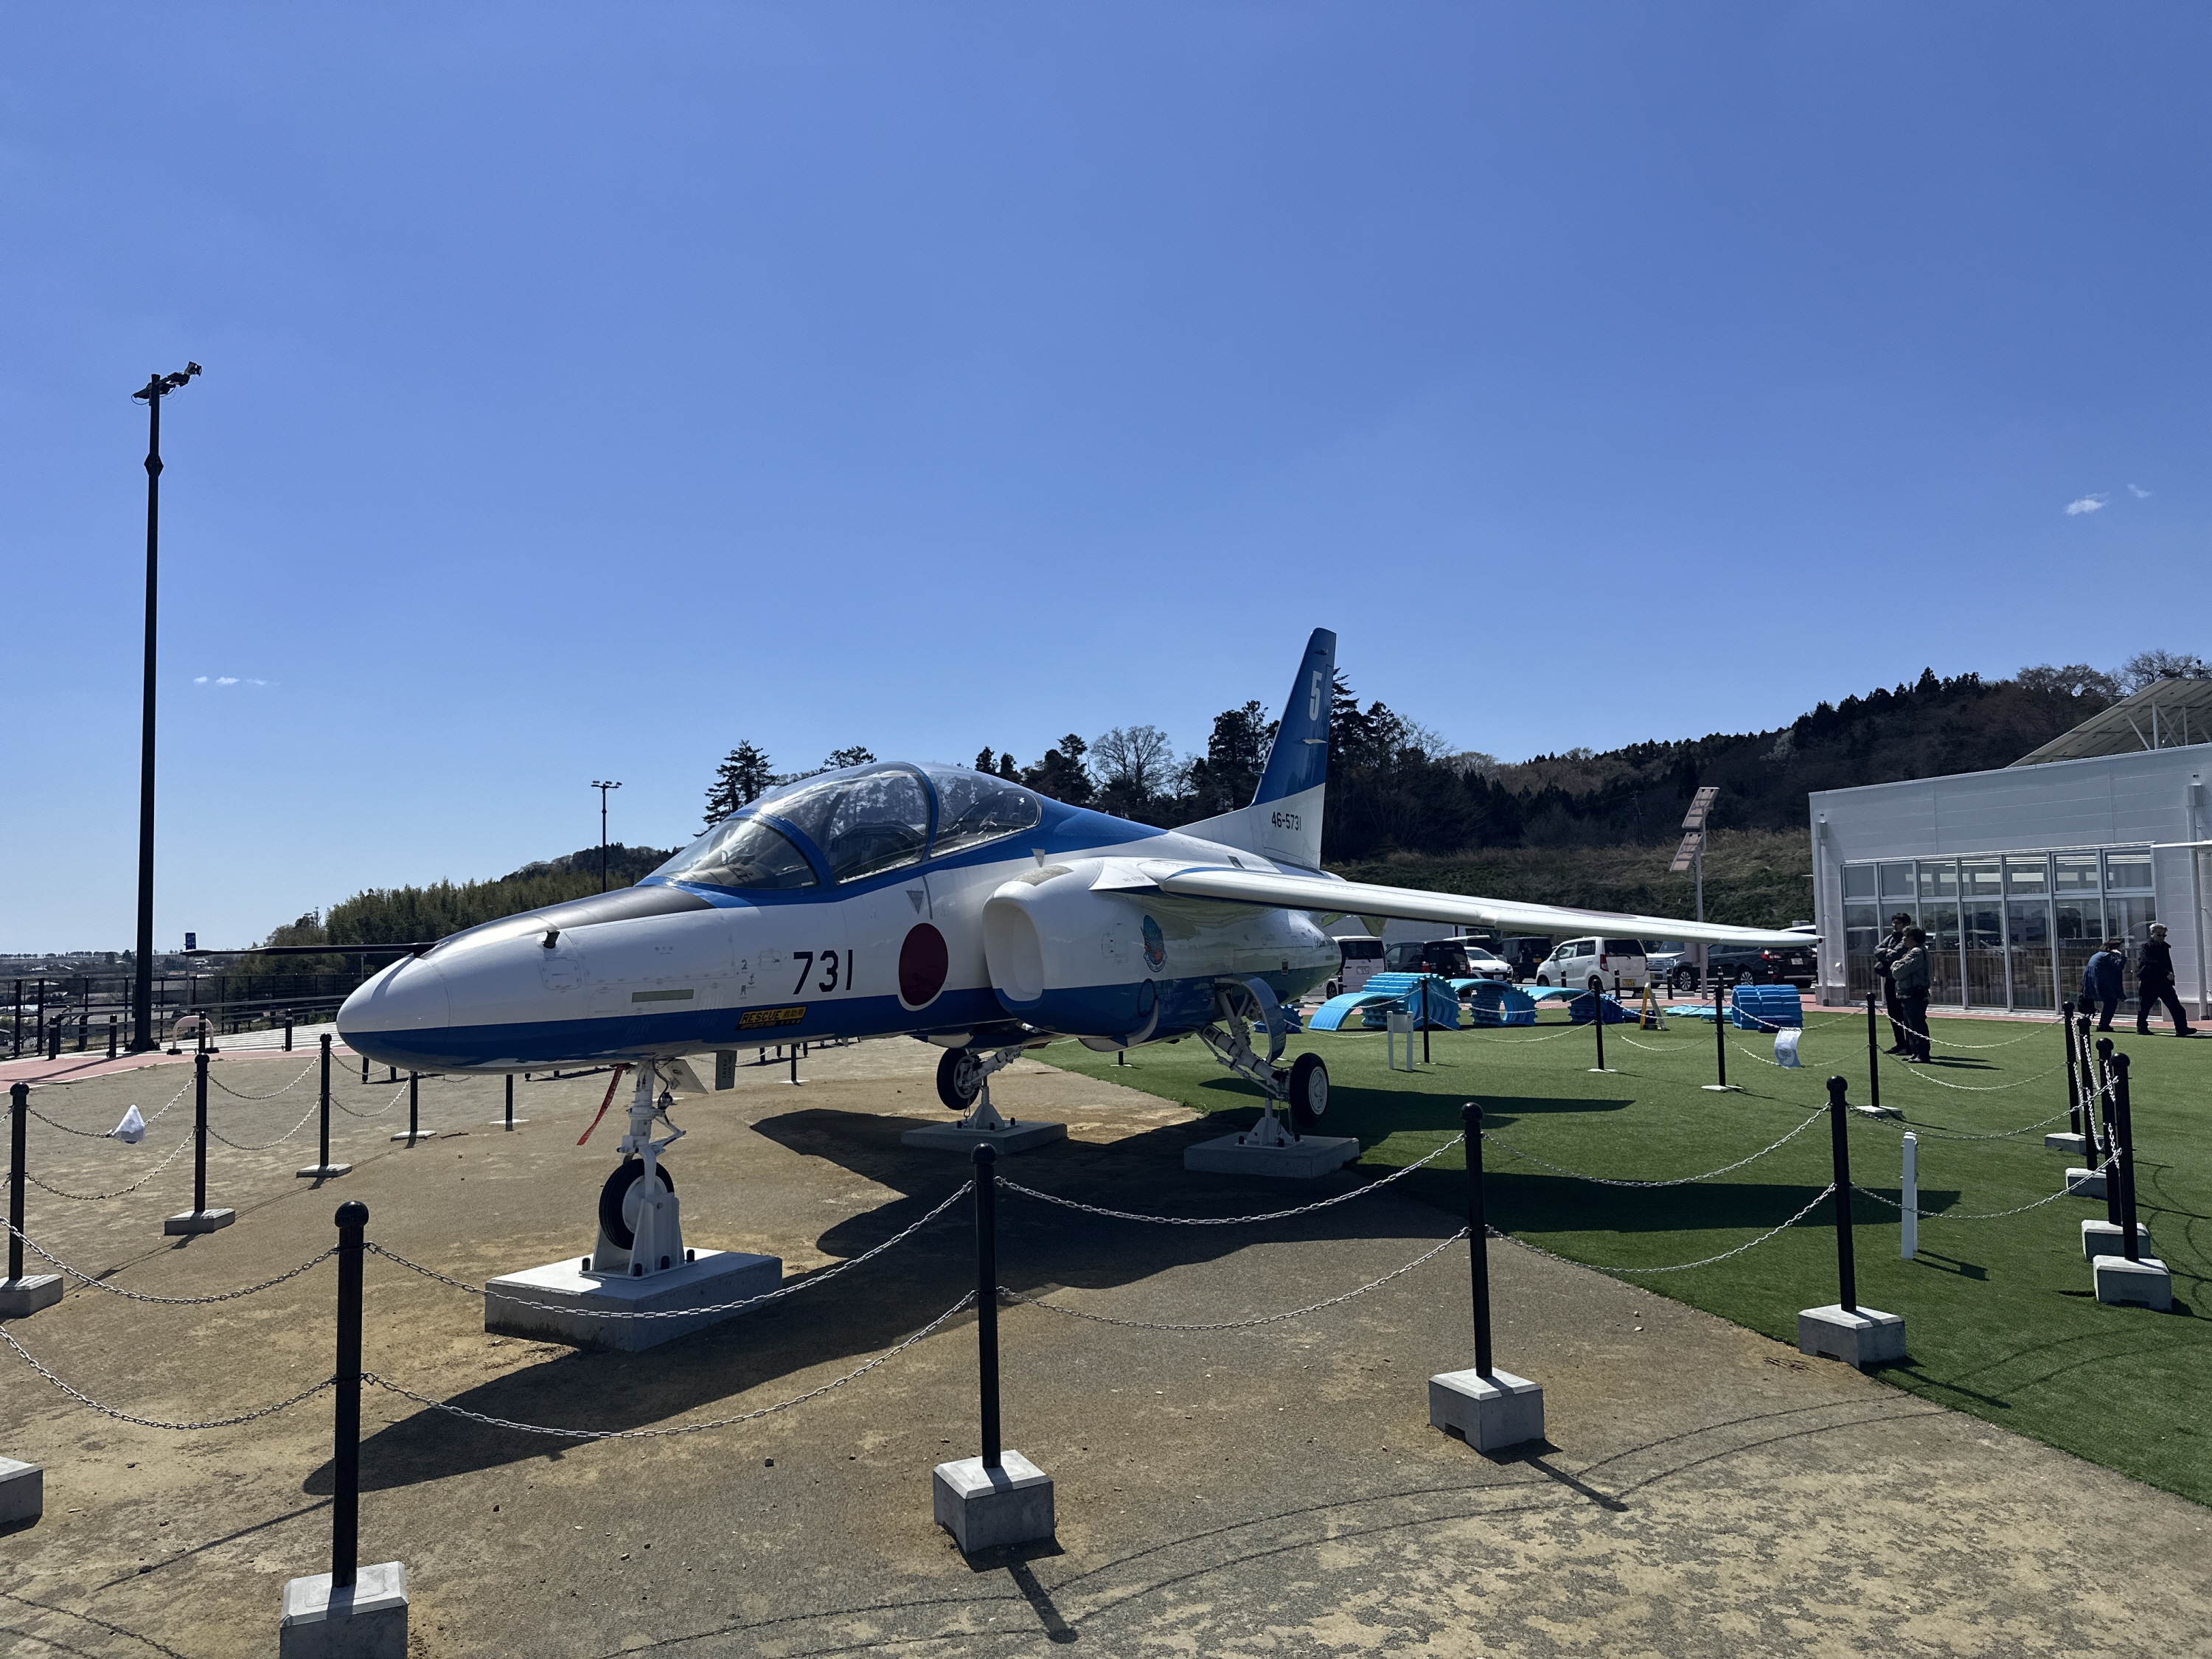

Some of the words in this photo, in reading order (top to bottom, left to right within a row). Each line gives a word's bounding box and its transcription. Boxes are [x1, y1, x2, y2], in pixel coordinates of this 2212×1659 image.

[1309, 669, 1323, 721] 5
[1271, 811, 1301, 832] 46-5731
[793, 949, 853, 995] 731
[741, 1011, 782, 1023] RESCUE
